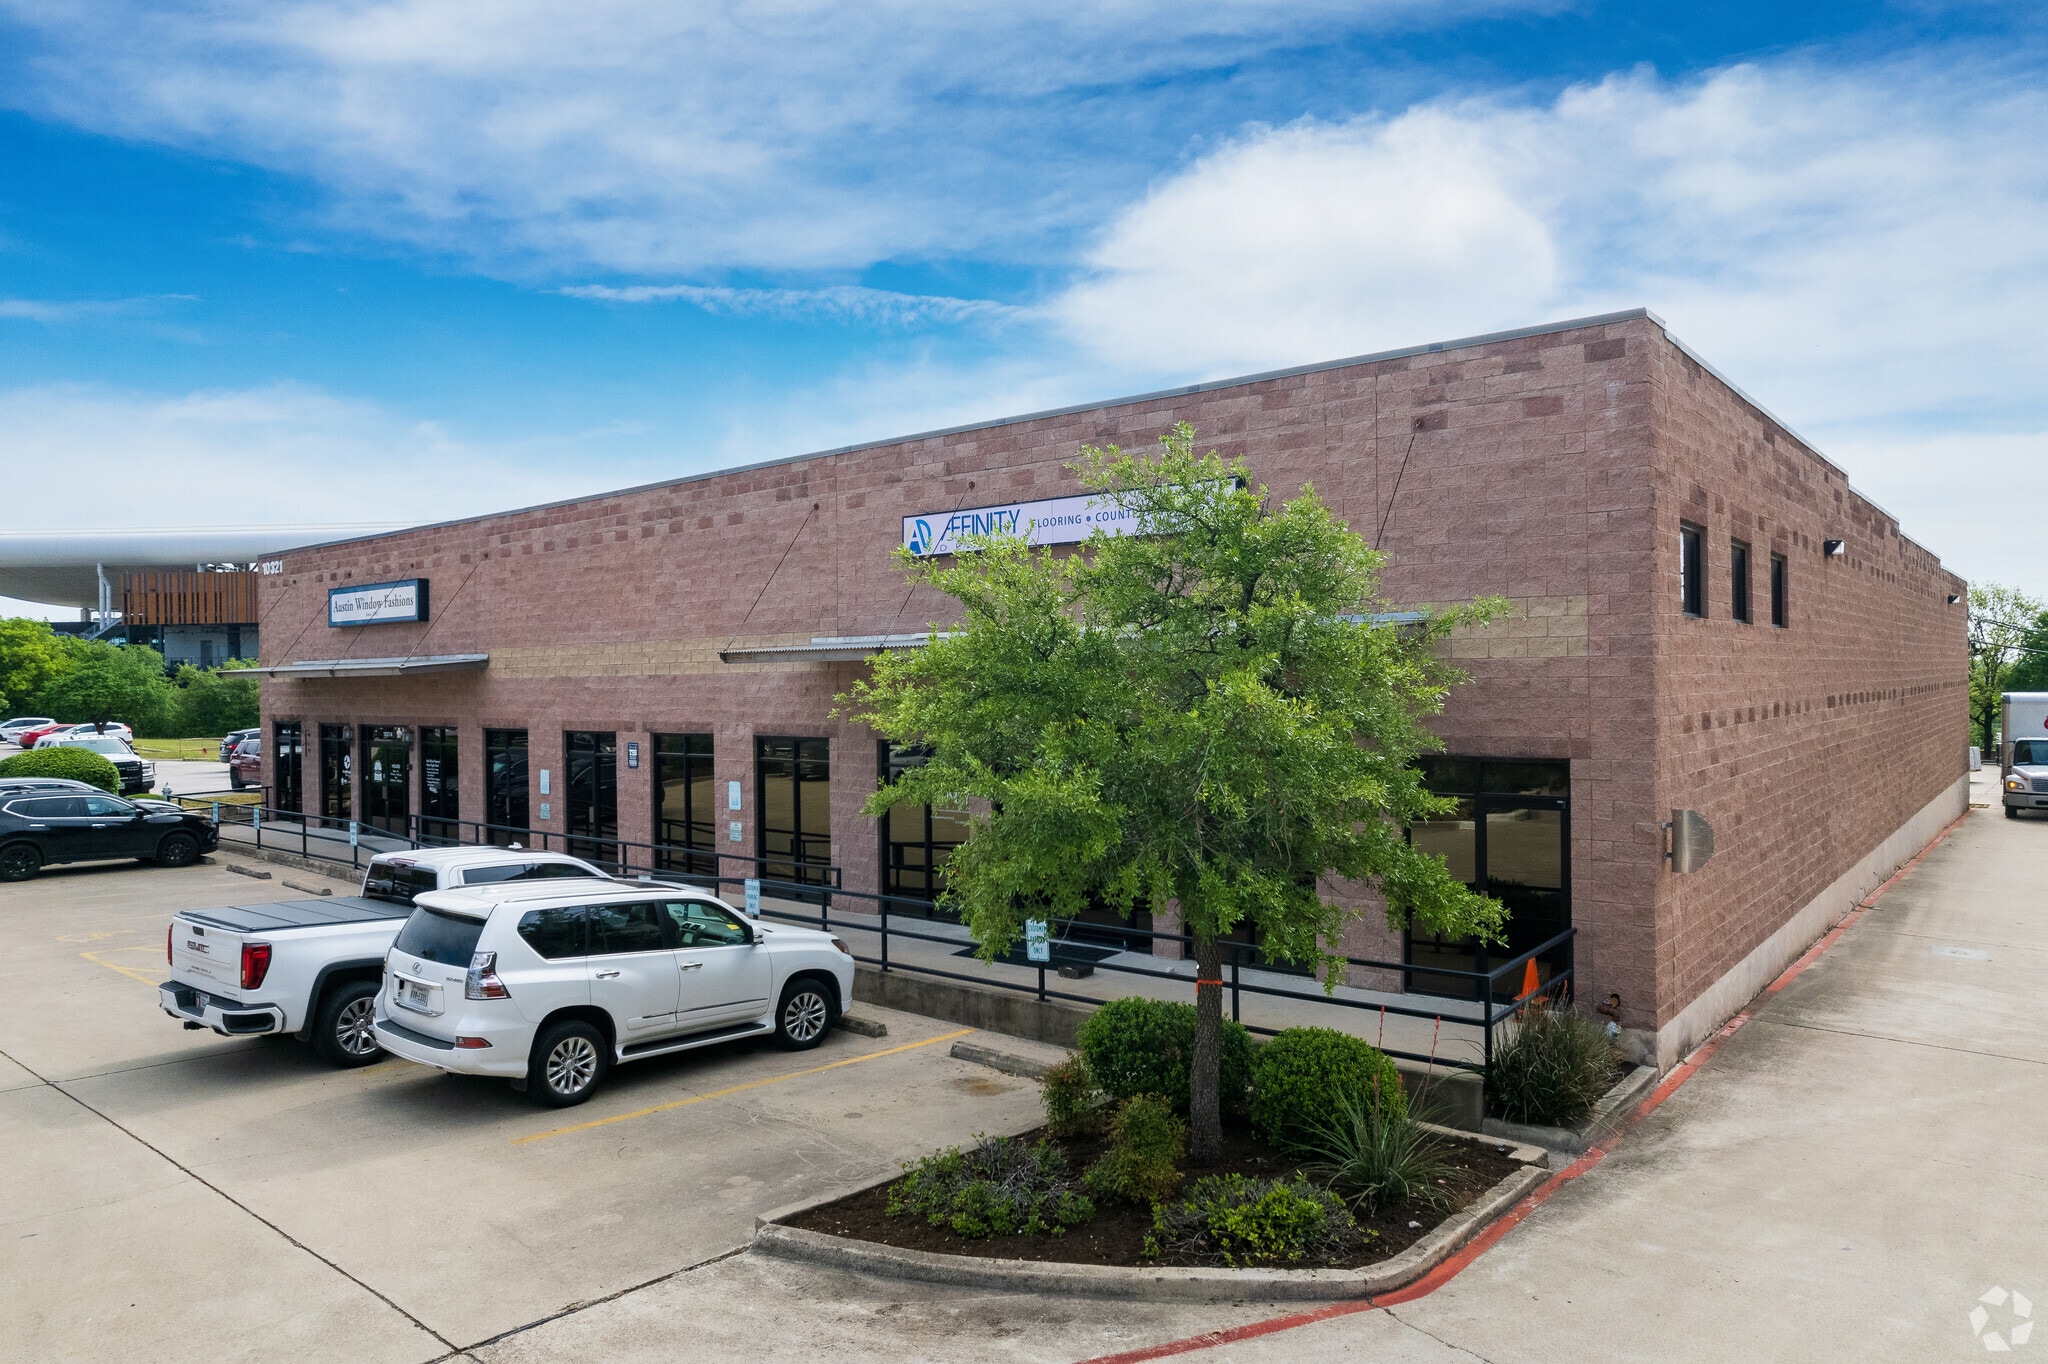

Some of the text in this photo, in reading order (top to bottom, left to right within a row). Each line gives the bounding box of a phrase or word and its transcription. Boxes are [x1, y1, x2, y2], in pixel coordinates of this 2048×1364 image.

[262, 560, 283, 576] 10321
[333, 594, 414, 613] Austin Window Fashions
[187, 940, 210, 955] GMC
